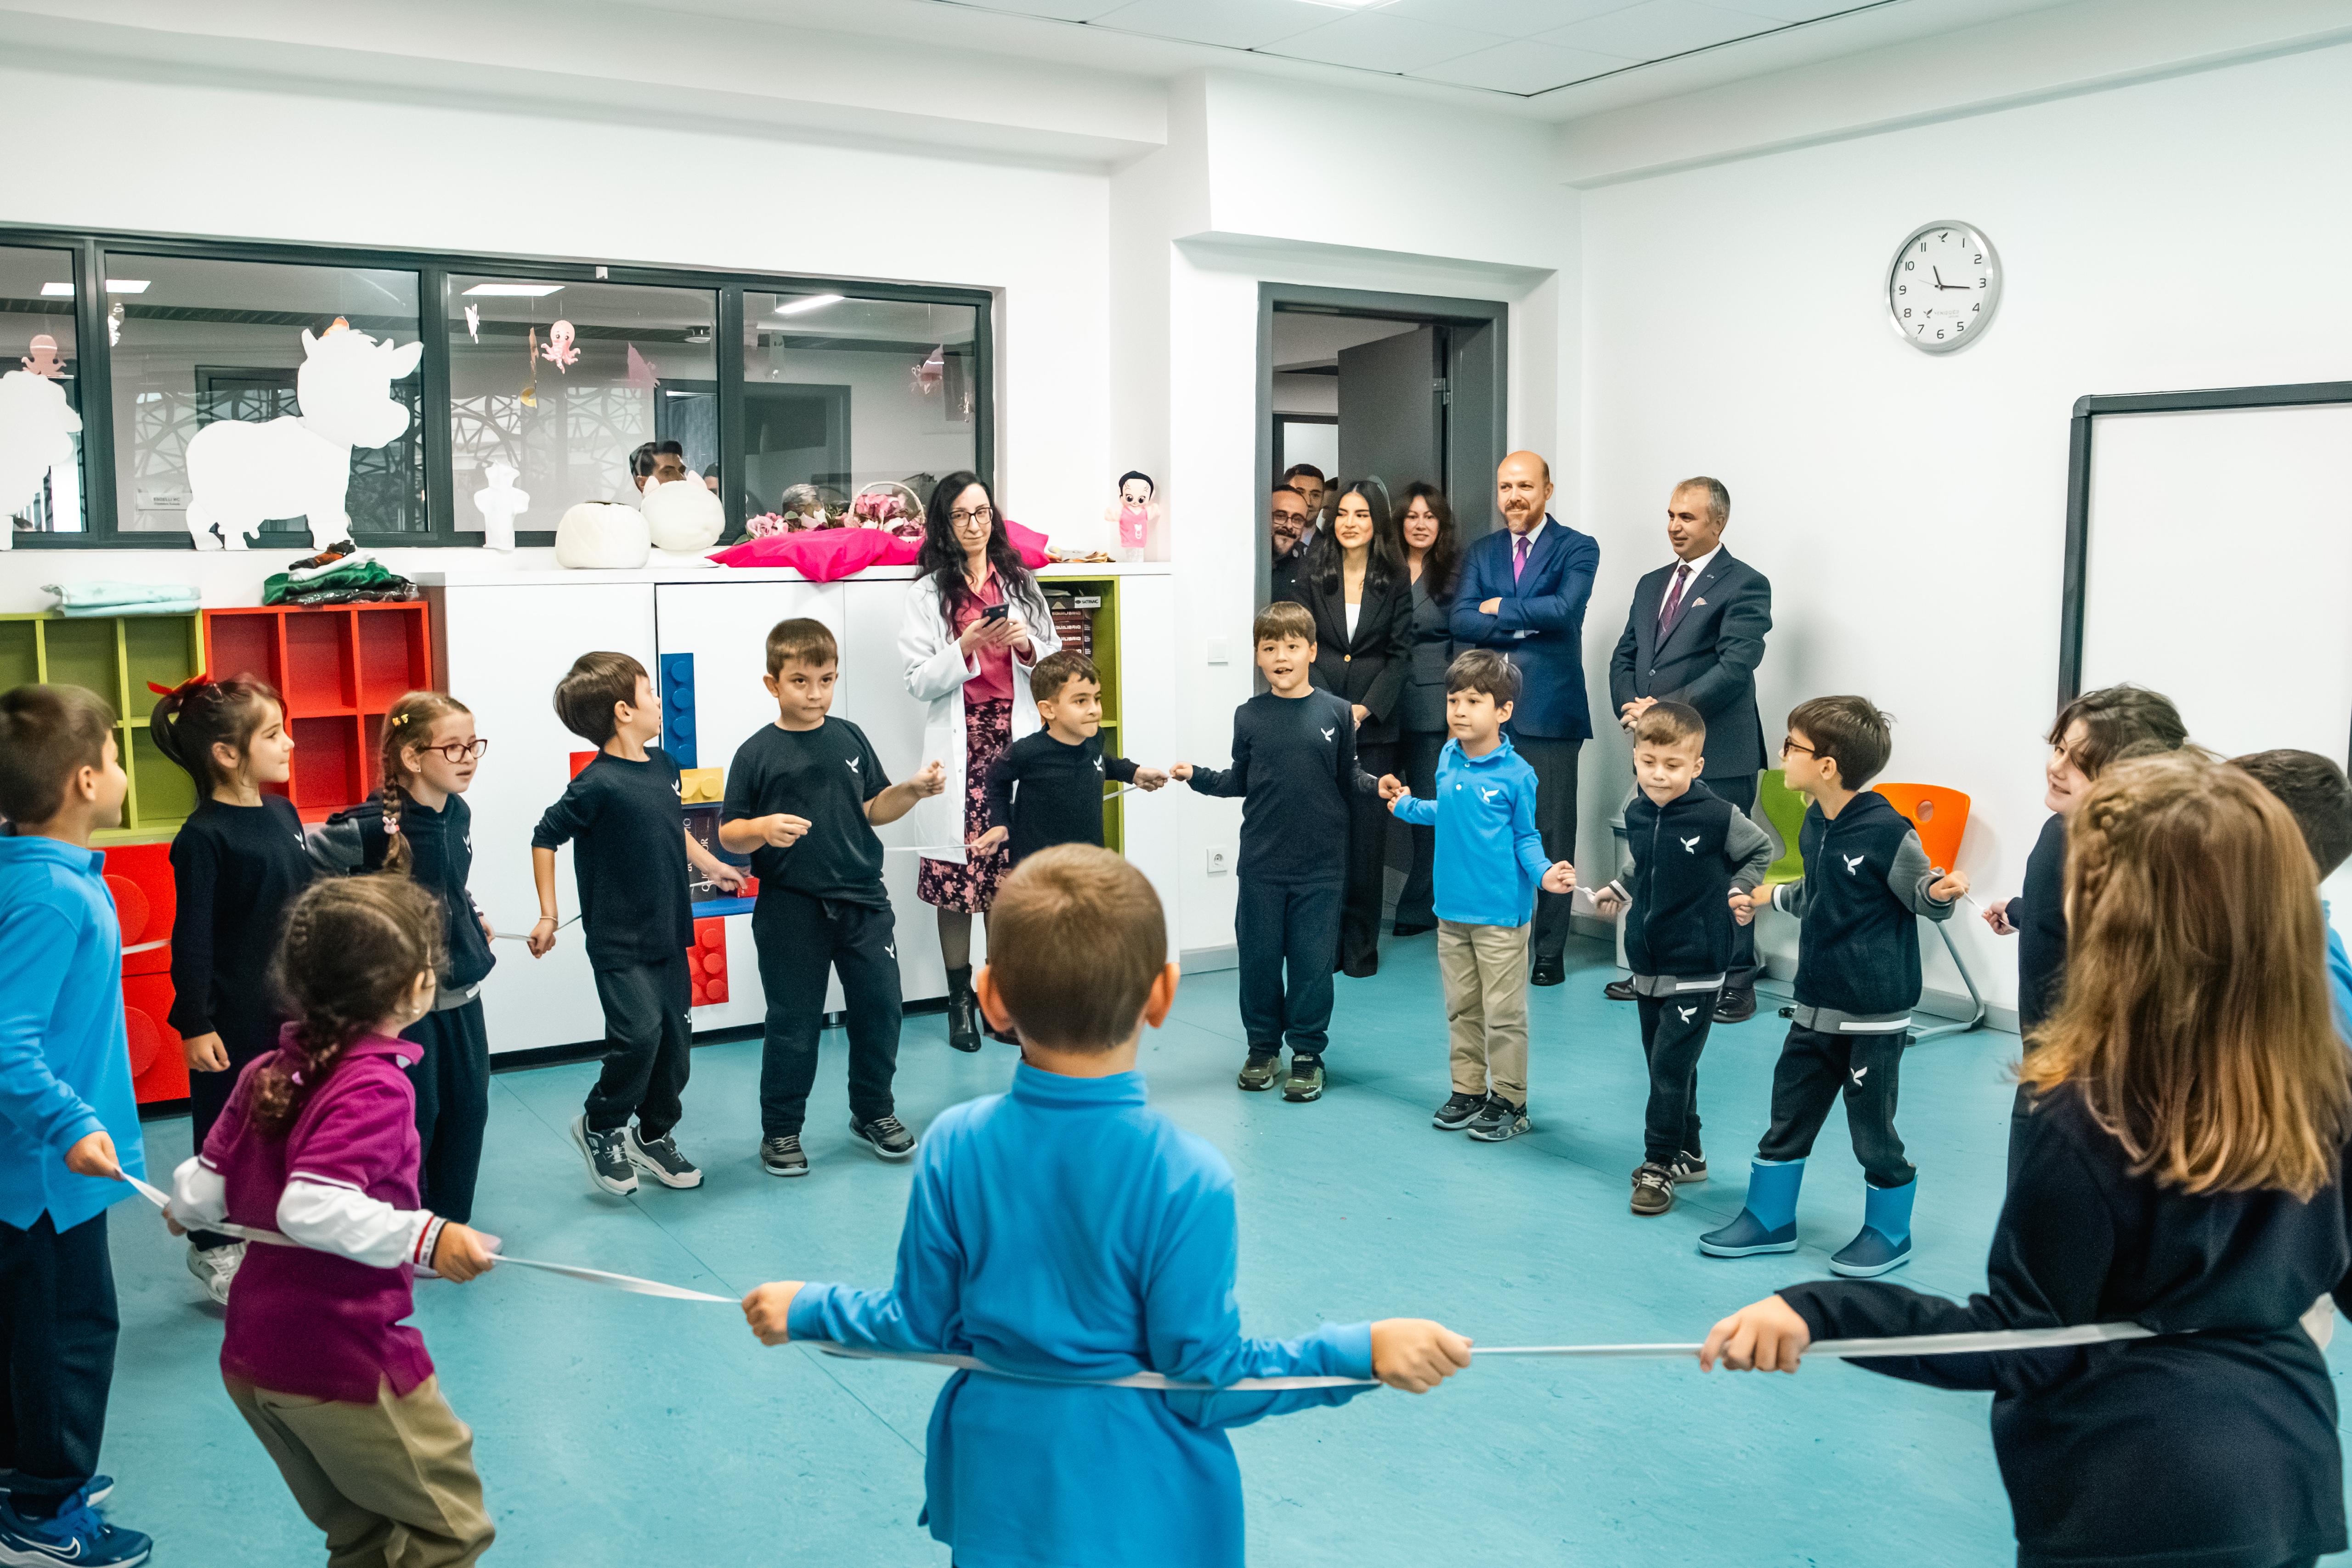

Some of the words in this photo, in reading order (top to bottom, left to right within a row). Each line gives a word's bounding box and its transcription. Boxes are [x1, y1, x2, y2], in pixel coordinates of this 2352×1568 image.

[1921, 242, 1926, 252] 11
[1974, 254, 1982, 264] 2
[1905, 261, 1915, 271] 10
[1979, 278, 1986, 288] 3
[1899, 285, 1906, 295] 9
[1972, 303, 1980, 312] 4
[1904, 308, 1911, 318] 8
[1917, 324, 1925, 334] 7
[1957, 321, 1964, 332] 5
[1937, 329, 1944, 339] 6
